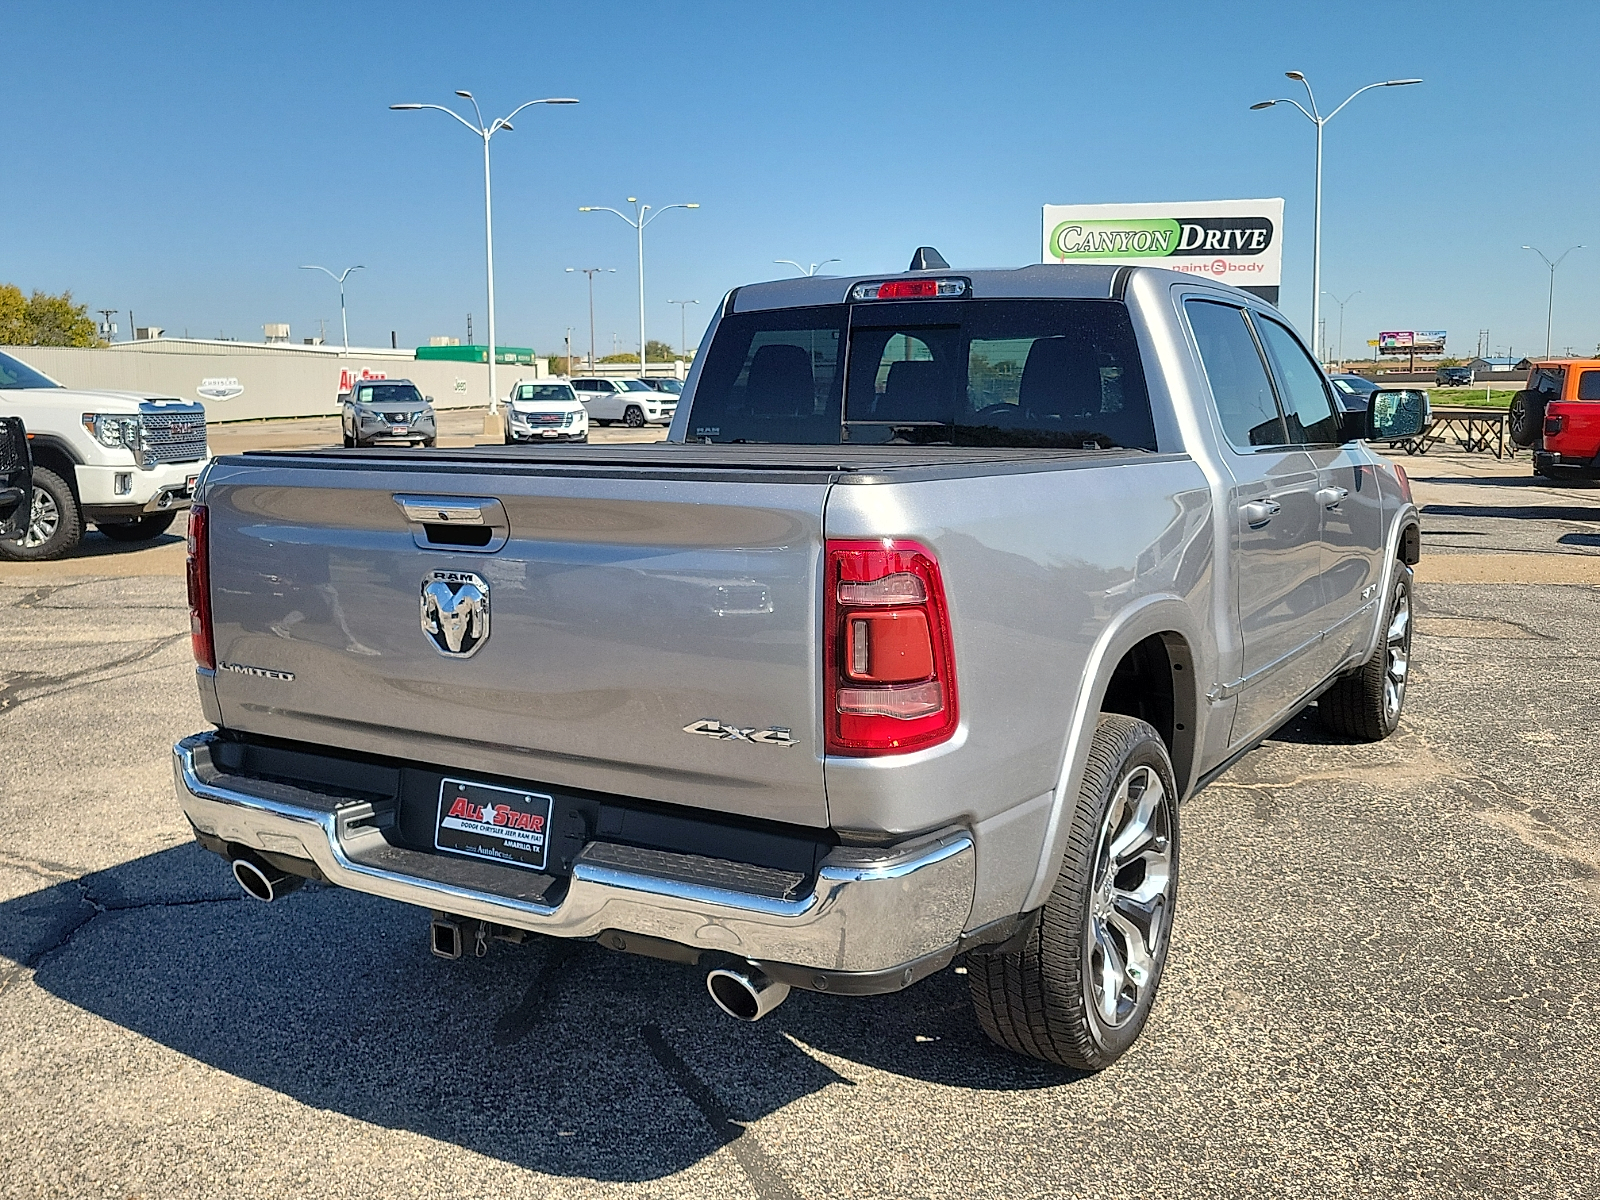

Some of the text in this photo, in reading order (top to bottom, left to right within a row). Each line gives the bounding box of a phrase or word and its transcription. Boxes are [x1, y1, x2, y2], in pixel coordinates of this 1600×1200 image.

[1057, 224, 1267, 253] CANYON DRIVE
[1172, 260, 1210, 273] paint
[1228, 259, 1265, 273] body
[454, 378, 467, 393] Jeep
[433, 572, 474, 582] RAM
[218, 660, 296, 683] LIMITED
[448, 797, 544, 832] ALL STAR
[460, 821, 479, 831] DODGE
[479, 824, 504, 836] CHRYSLER
[530, 833, 542, 842] FIAT
